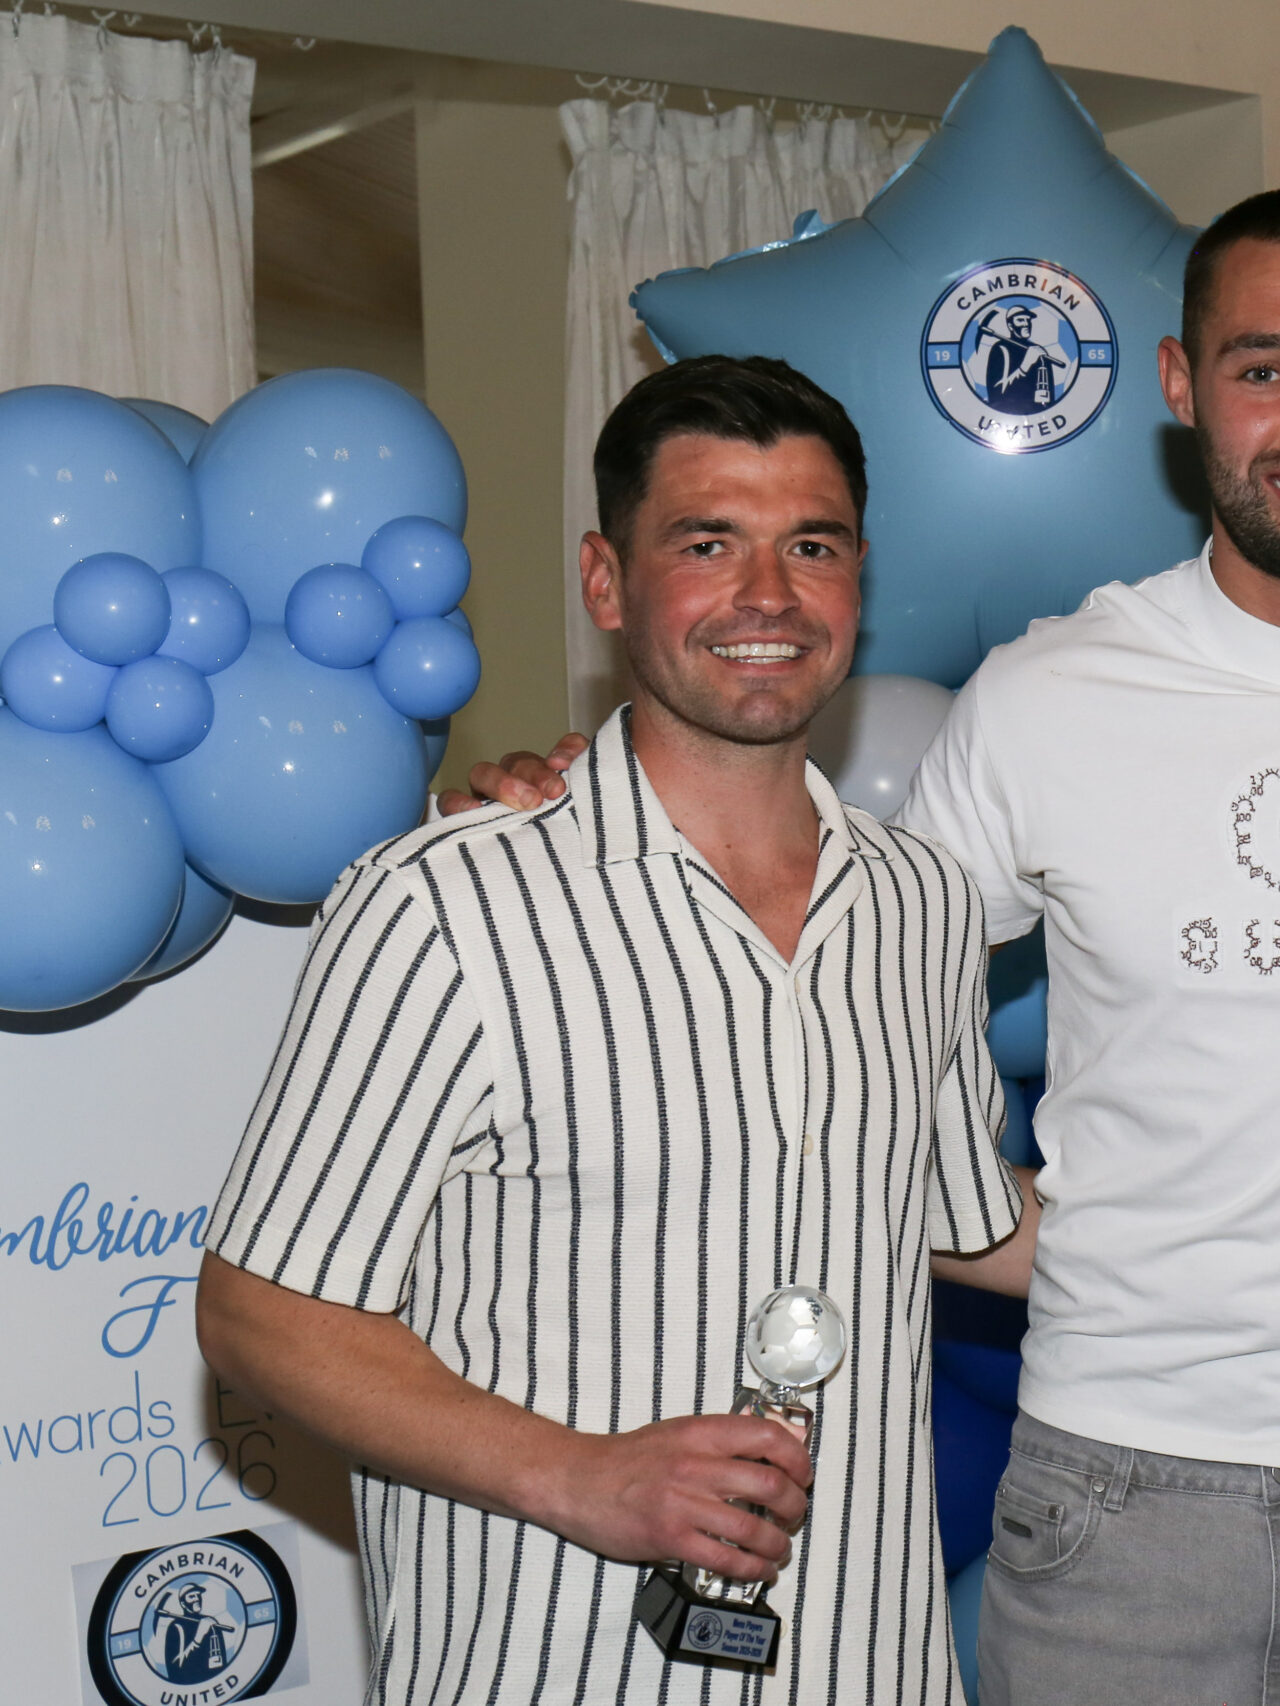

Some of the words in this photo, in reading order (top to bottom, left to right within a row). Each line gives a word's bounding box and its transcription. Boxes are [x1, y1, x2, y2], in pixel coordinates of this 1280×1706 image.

[957, 274, 1080, 311] CAMBRIAN
[934, 350, 951, 362] 19
[1088, 349, 1105, 360] 65
[978, 414, 1067, 439] UTED
[2, 1370, 175, 1462] wards
[99, 1430, 277, 1527] 2026
[134, 1552, 245, 1599] CAMBRIAN
[116, 1638, 132, 1650] 19
[253, 1607, 270, 1619] 65
[160, 1674, 240, 1706] UNITED
